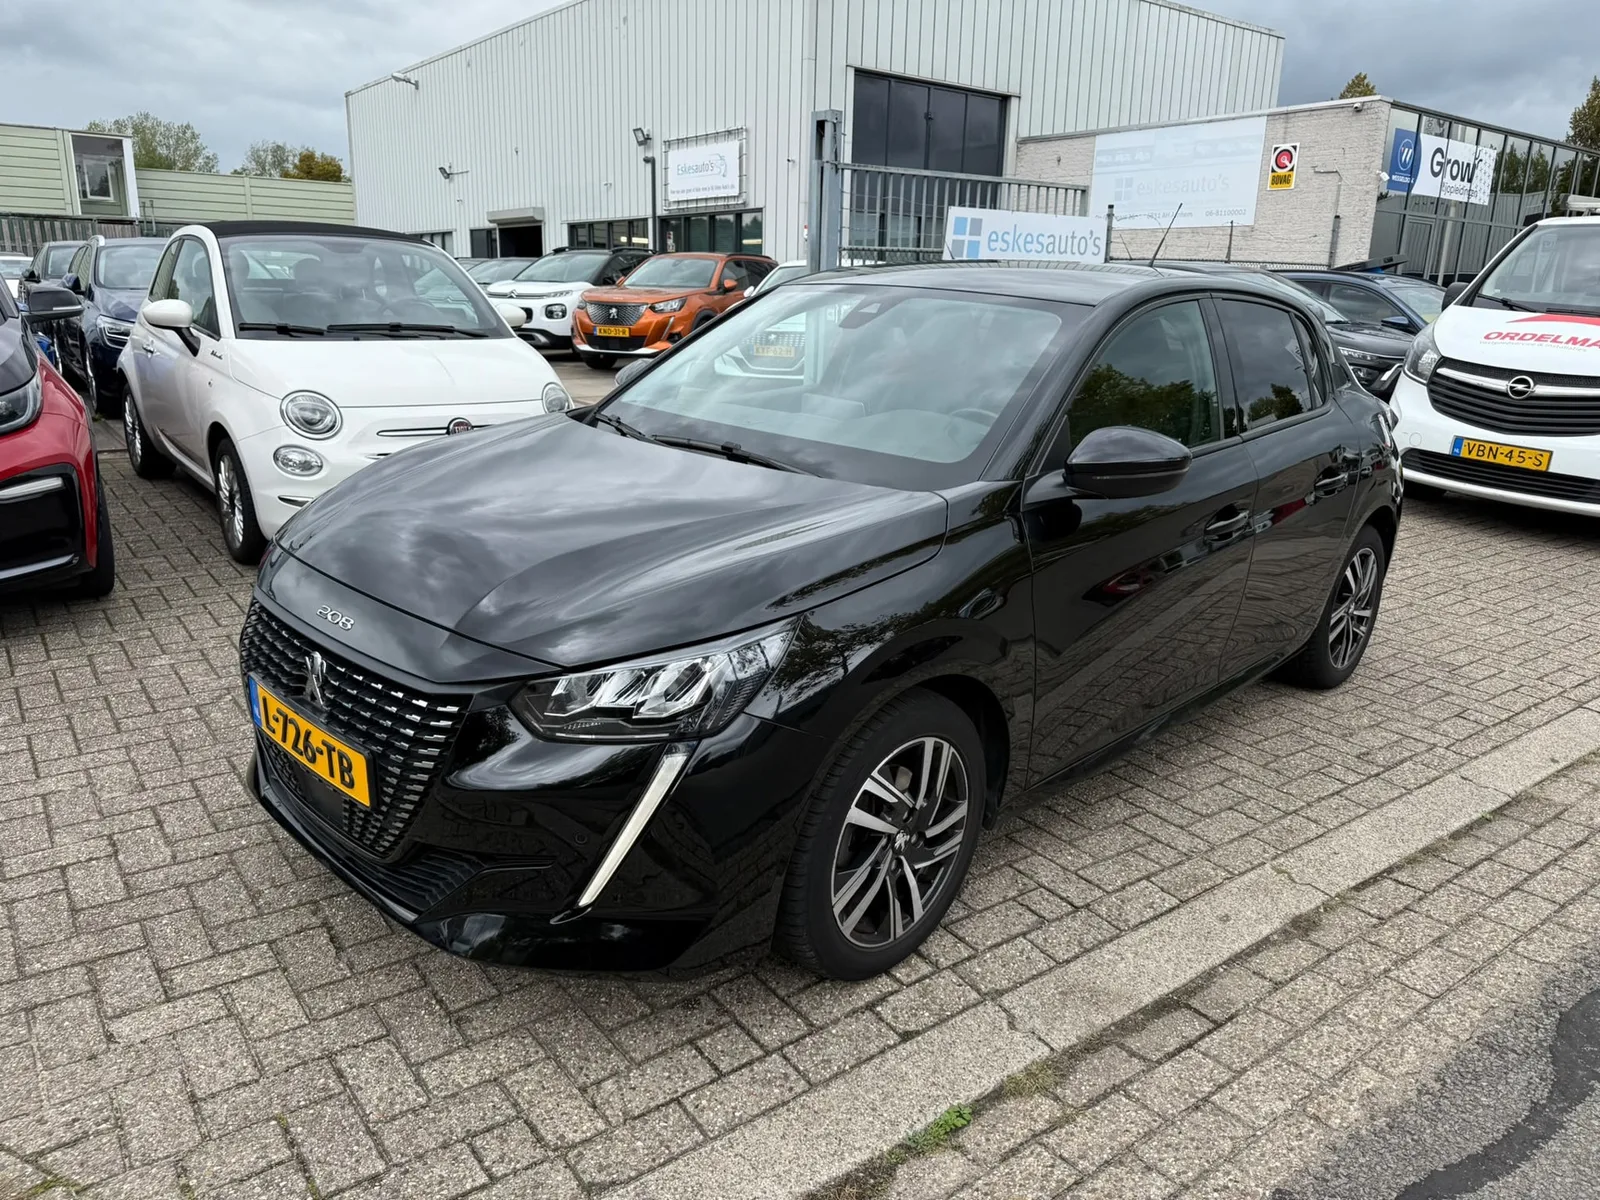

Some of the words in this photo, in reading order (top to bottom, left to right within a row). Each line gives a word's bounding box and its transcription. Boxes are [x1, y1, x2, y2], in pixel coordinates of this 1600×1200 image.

[676, 160, 714, 176] Eskesauto's
[1271, 174, 1292, 186] BOVAG
[1136, 173, 1230, 196] eskesauto's
[987, 223, 1101, 257] eskesauto's
[1466, 440, 1545, 467] VBN-45-S
[316, 605, 355, 632] 208
[262, 695, 355, 790] L-726-TB
